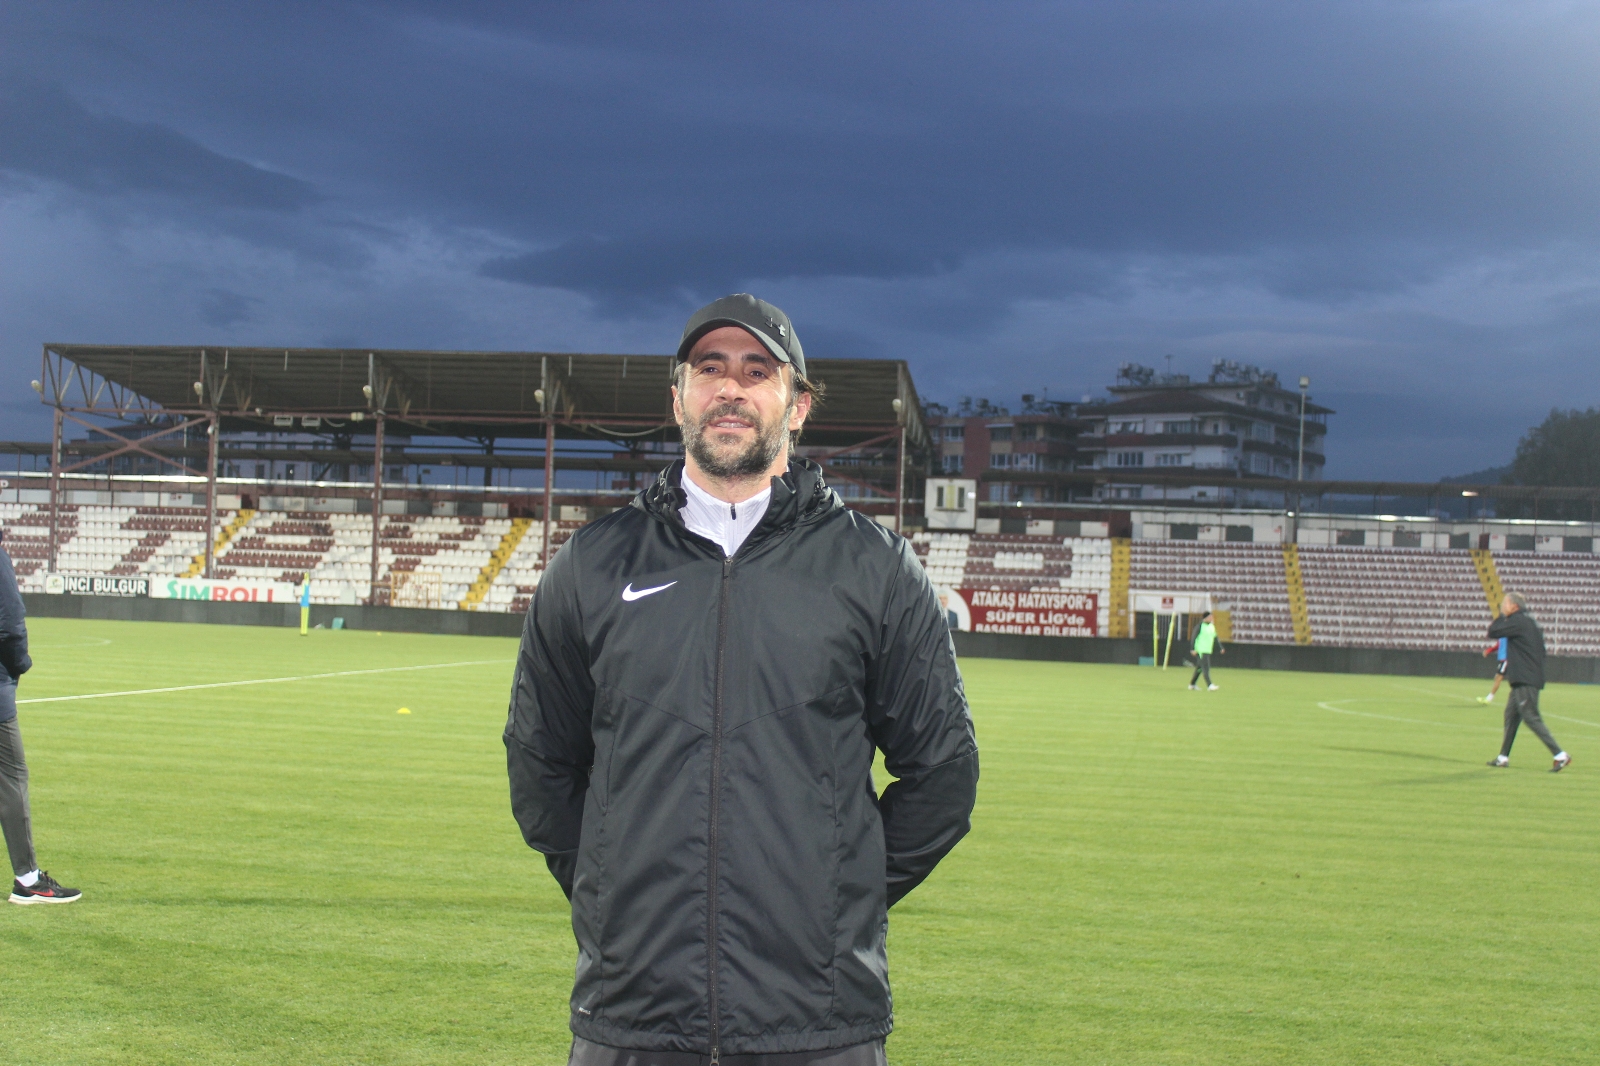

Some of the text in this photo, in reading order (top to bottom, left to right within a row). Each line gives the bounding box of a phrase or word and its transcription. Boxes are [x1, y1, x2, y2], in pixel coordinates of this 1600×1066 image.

[93, 577, 147, 595] BULGUR
[971, 591, 1016, 611] ATAKAŞ
[985, 609, 1036, 624] SÜPER
